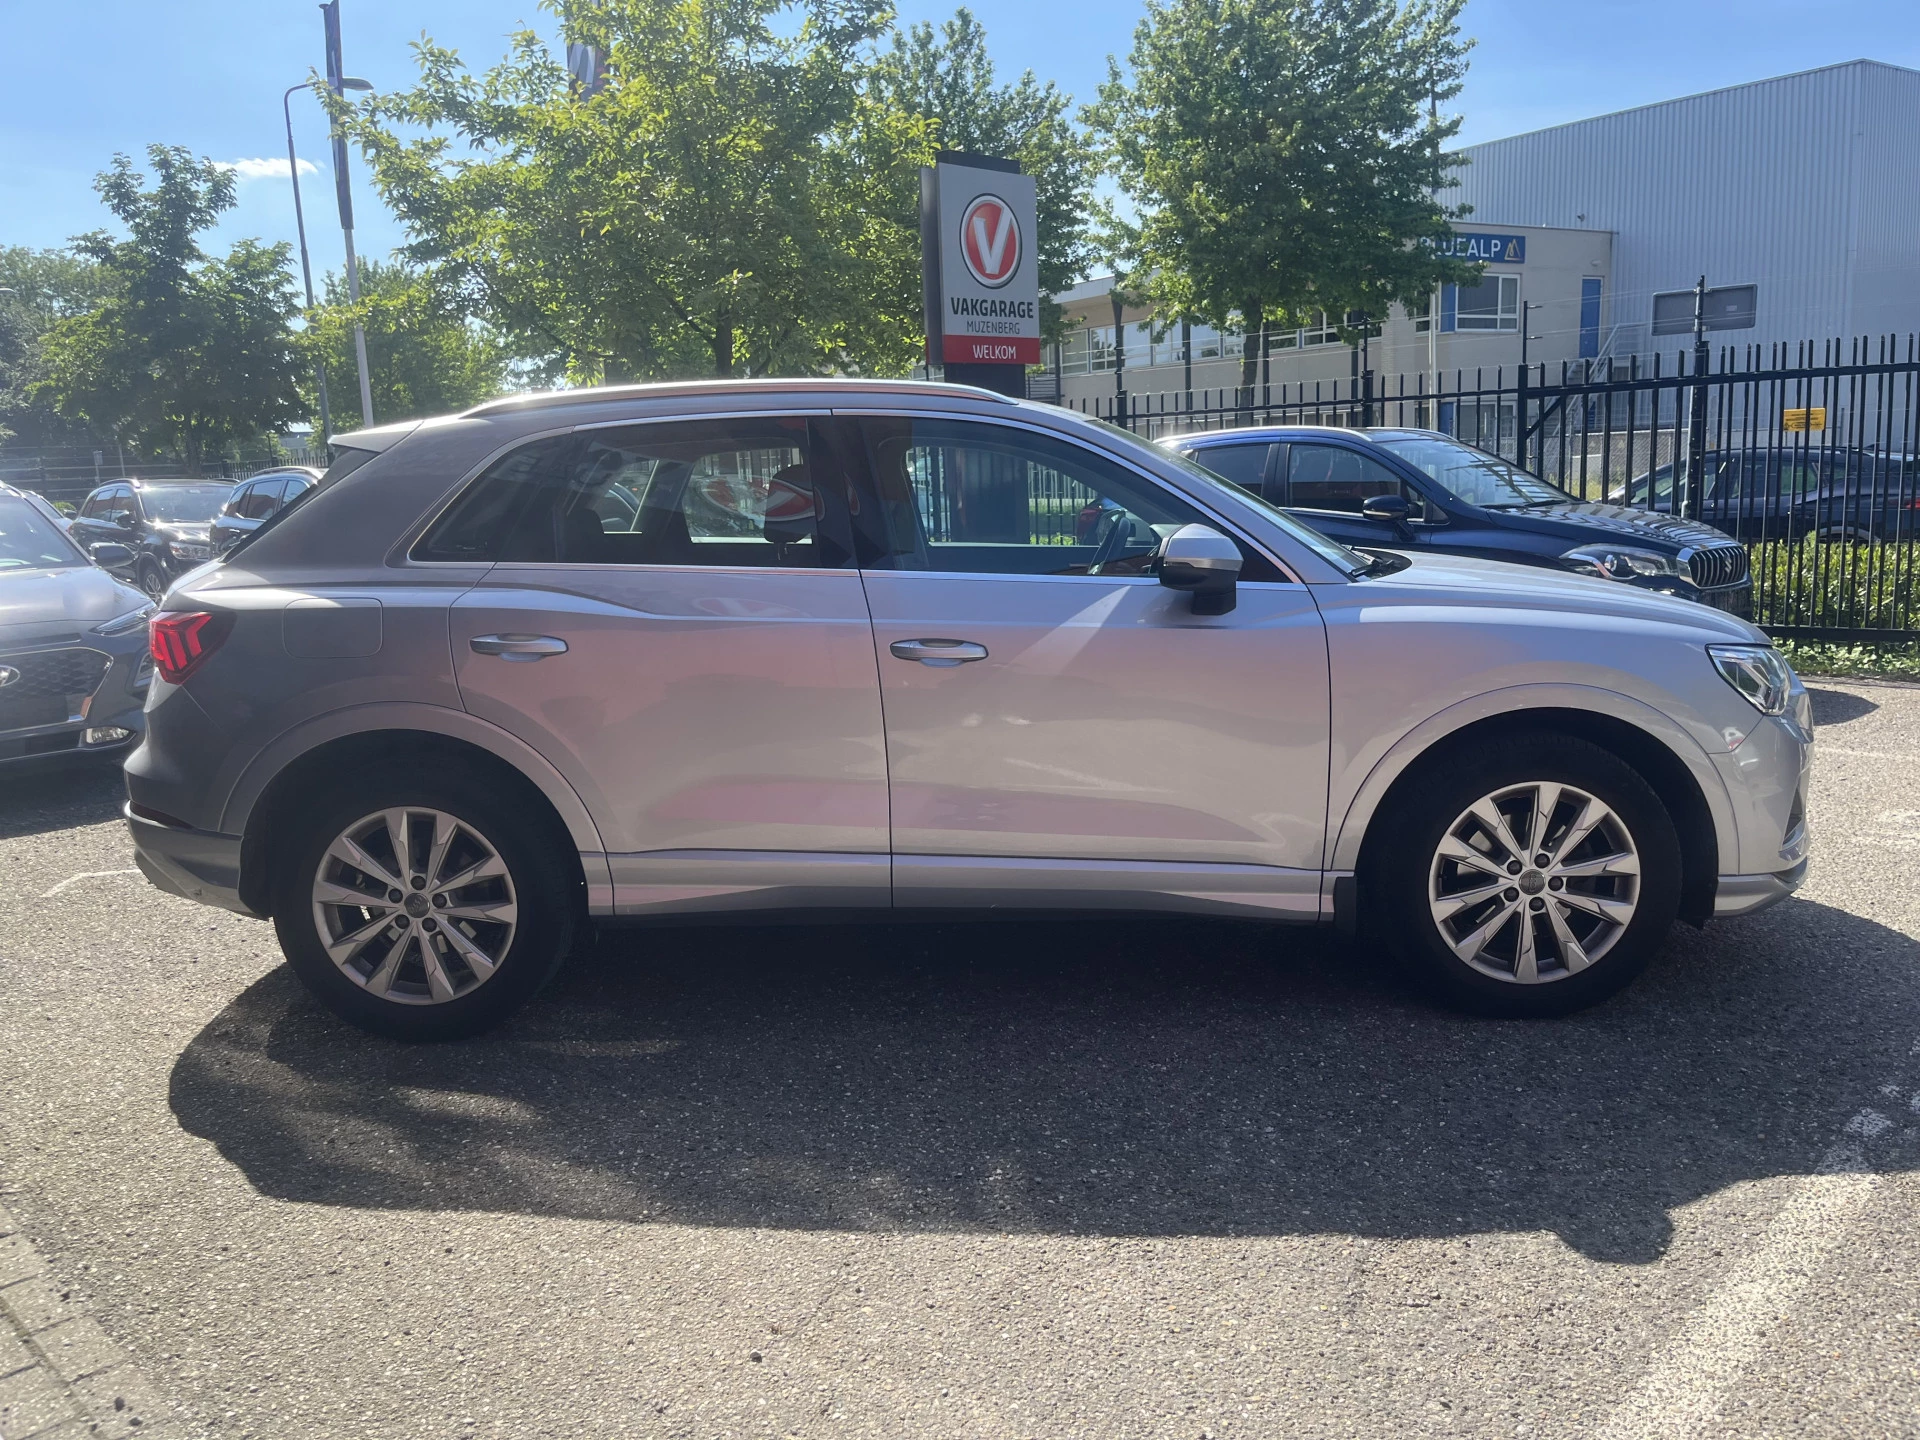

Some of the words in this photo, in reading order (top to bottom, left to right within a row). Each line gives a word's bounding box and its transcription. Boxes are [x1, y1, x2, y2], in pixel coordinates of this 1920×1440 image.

[973, 205, 1012, 275] V
[1420, 236, 1501, 258] UEALP
[951, 297, 1034, 319] VAKGARAGE
[966, 320, 1020, 335] MUZENBERG
[973, 344, 1017, 360] WELKOM
